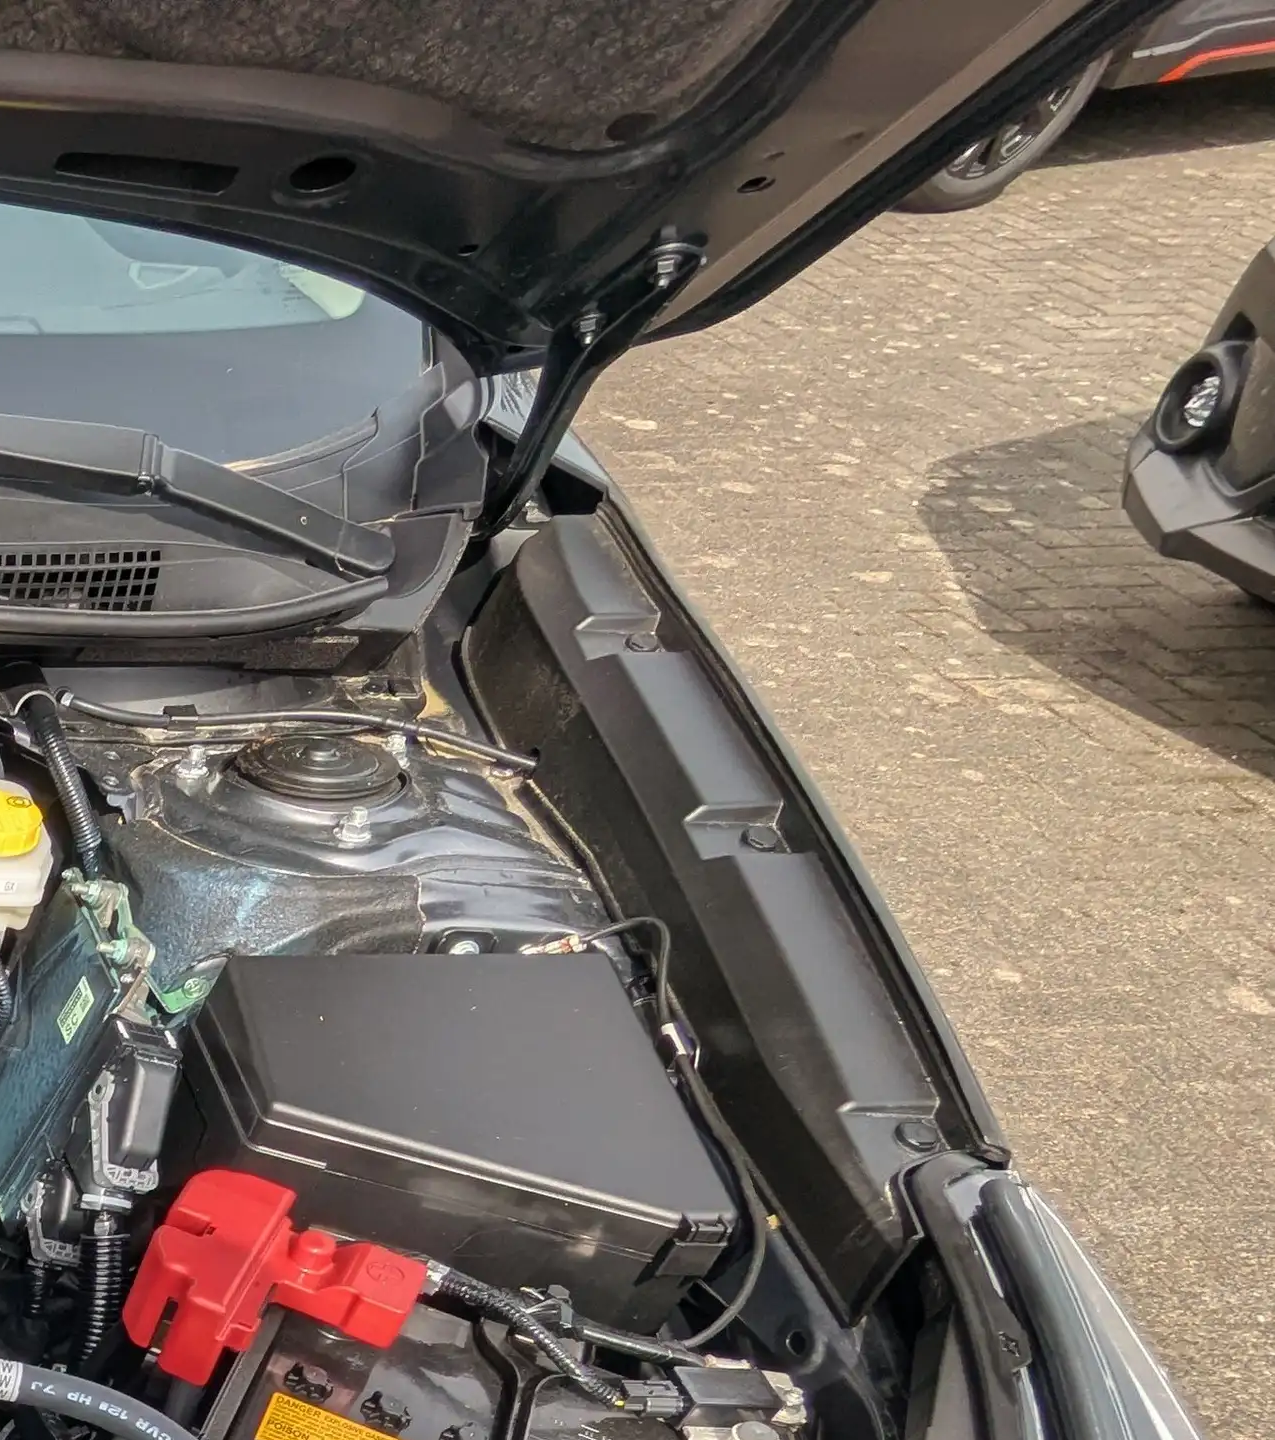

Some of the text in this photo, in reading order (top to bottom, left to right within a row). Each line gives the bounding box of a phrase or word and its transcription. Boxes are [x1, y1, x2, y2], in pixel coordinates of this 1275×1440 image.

[0, 1375, 12, 1388] W
[66, 1391, 93, 1406] HP
[275, 1394, 322, 1419] DANGER
[323, 1414, 364, 1435] EXPLOSIVE
